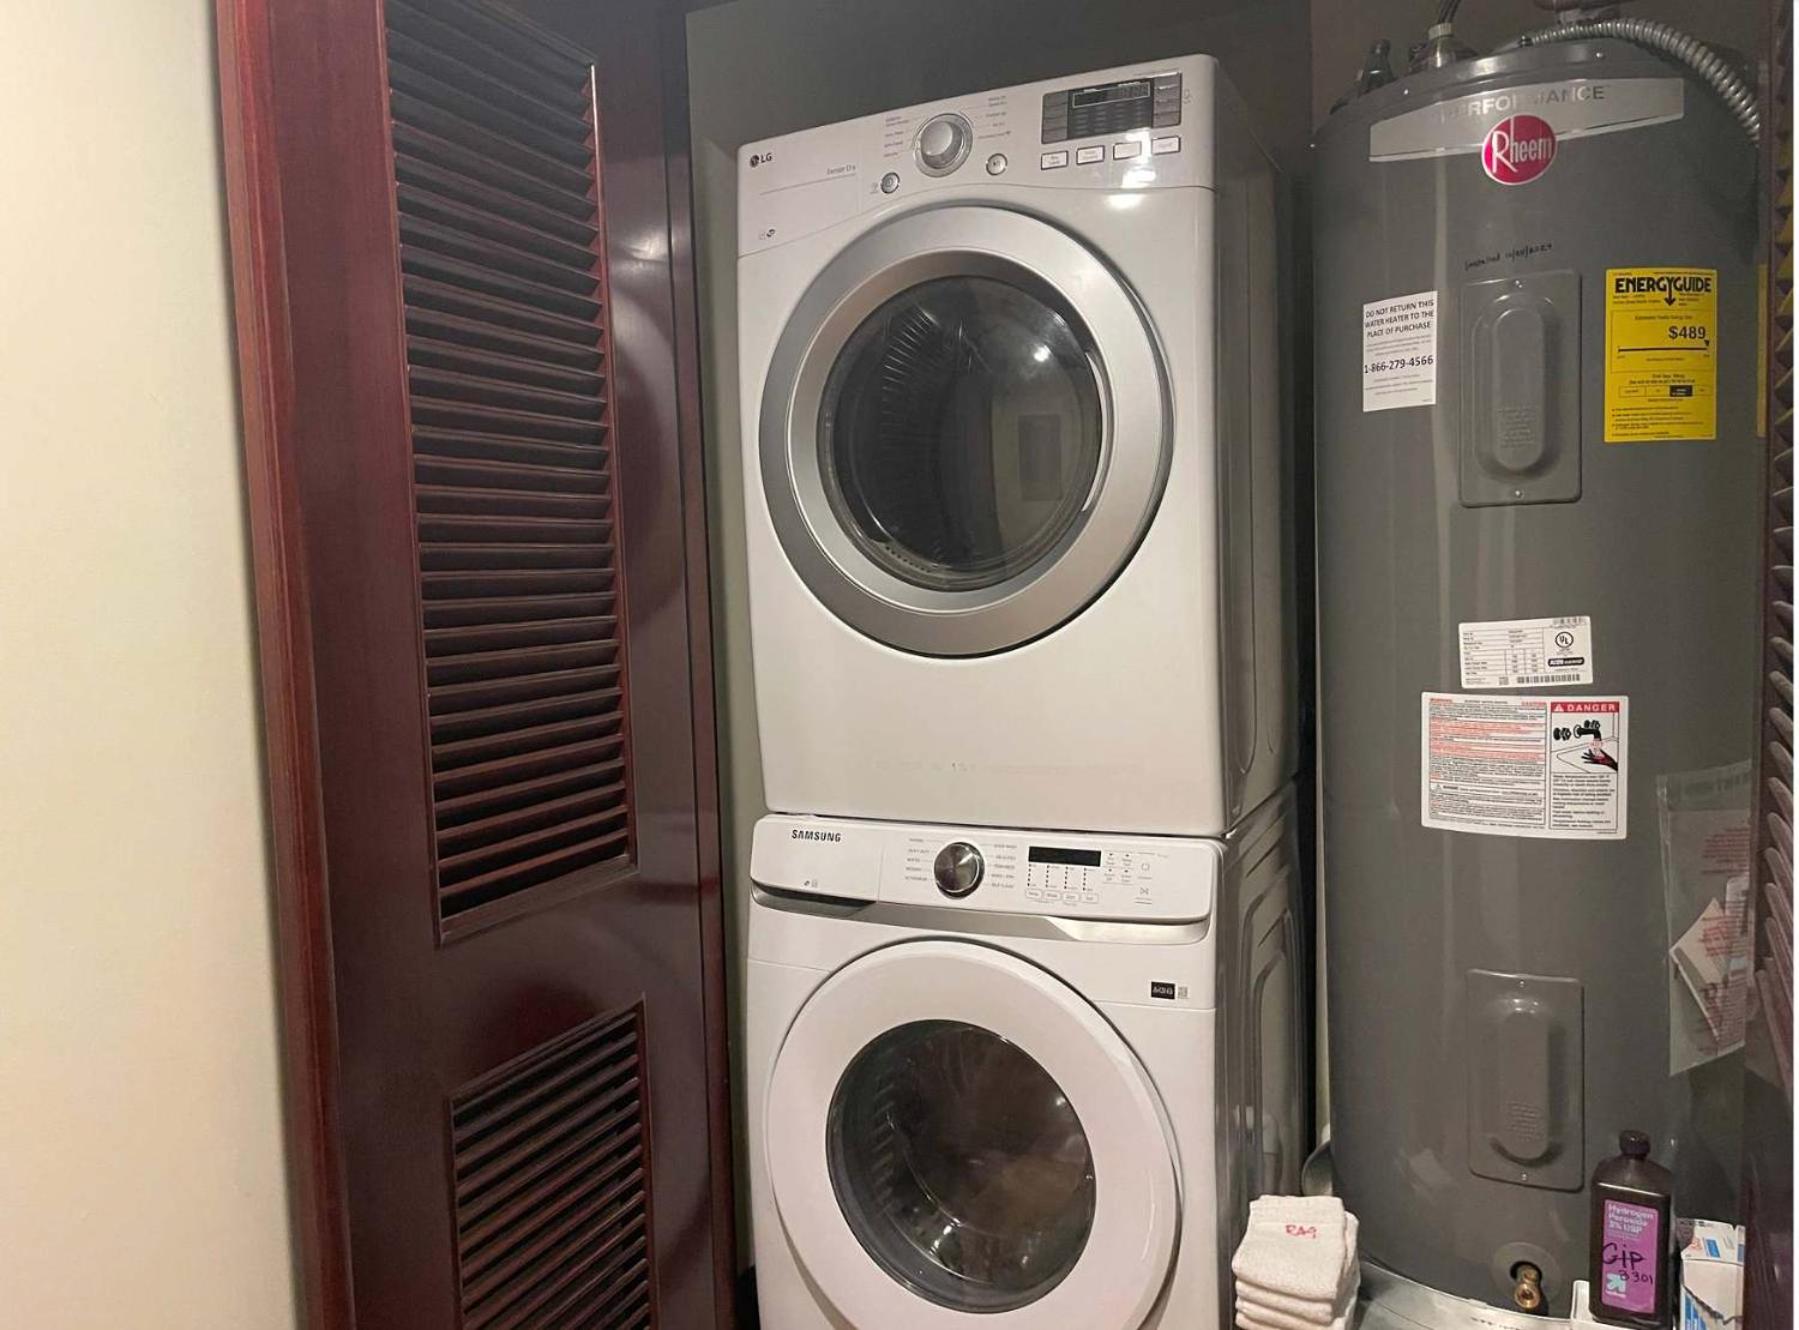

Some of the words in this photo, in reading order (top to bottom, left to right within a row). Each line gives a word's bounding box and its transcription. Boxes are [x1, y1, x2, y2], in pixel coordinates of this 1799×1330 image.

[1440, 85, 1606, 124] RFOANCE
[1491, 117, 1553, 173] Rheem
[1615, 276, 1712, 294] ENERGYGUIDE
[1365, 310, 1375, 318] DO
[1376, 307, 1388, 316] NOT
[1390, 303, 1416, 312] RETURN
[1418, 300, 1434, 308] THIS
[1365, 319, 1384, 328] WATER
[1385, 314, 1409, 325] HEATER
[1410, 312, 1420, 320] TO
[1421, 309, 1434, 318] THE
[1367, 329, 1384, 338] PLACE
[1385, 326, 1394, 335] OF
[1395, 321, 1431, 334] PURCHASE
[1668, 325, 1706, 340] $489
[1364, 355, 1434, 374] 1-866-279-4566
[1567, 703, 1616, 712] DANGER
[791, 829, 842, 843] SAMSUNG
[1608, 1203, 1654, 1221] Hydrogen
[1623, 1223, 1643, 1234] USP
